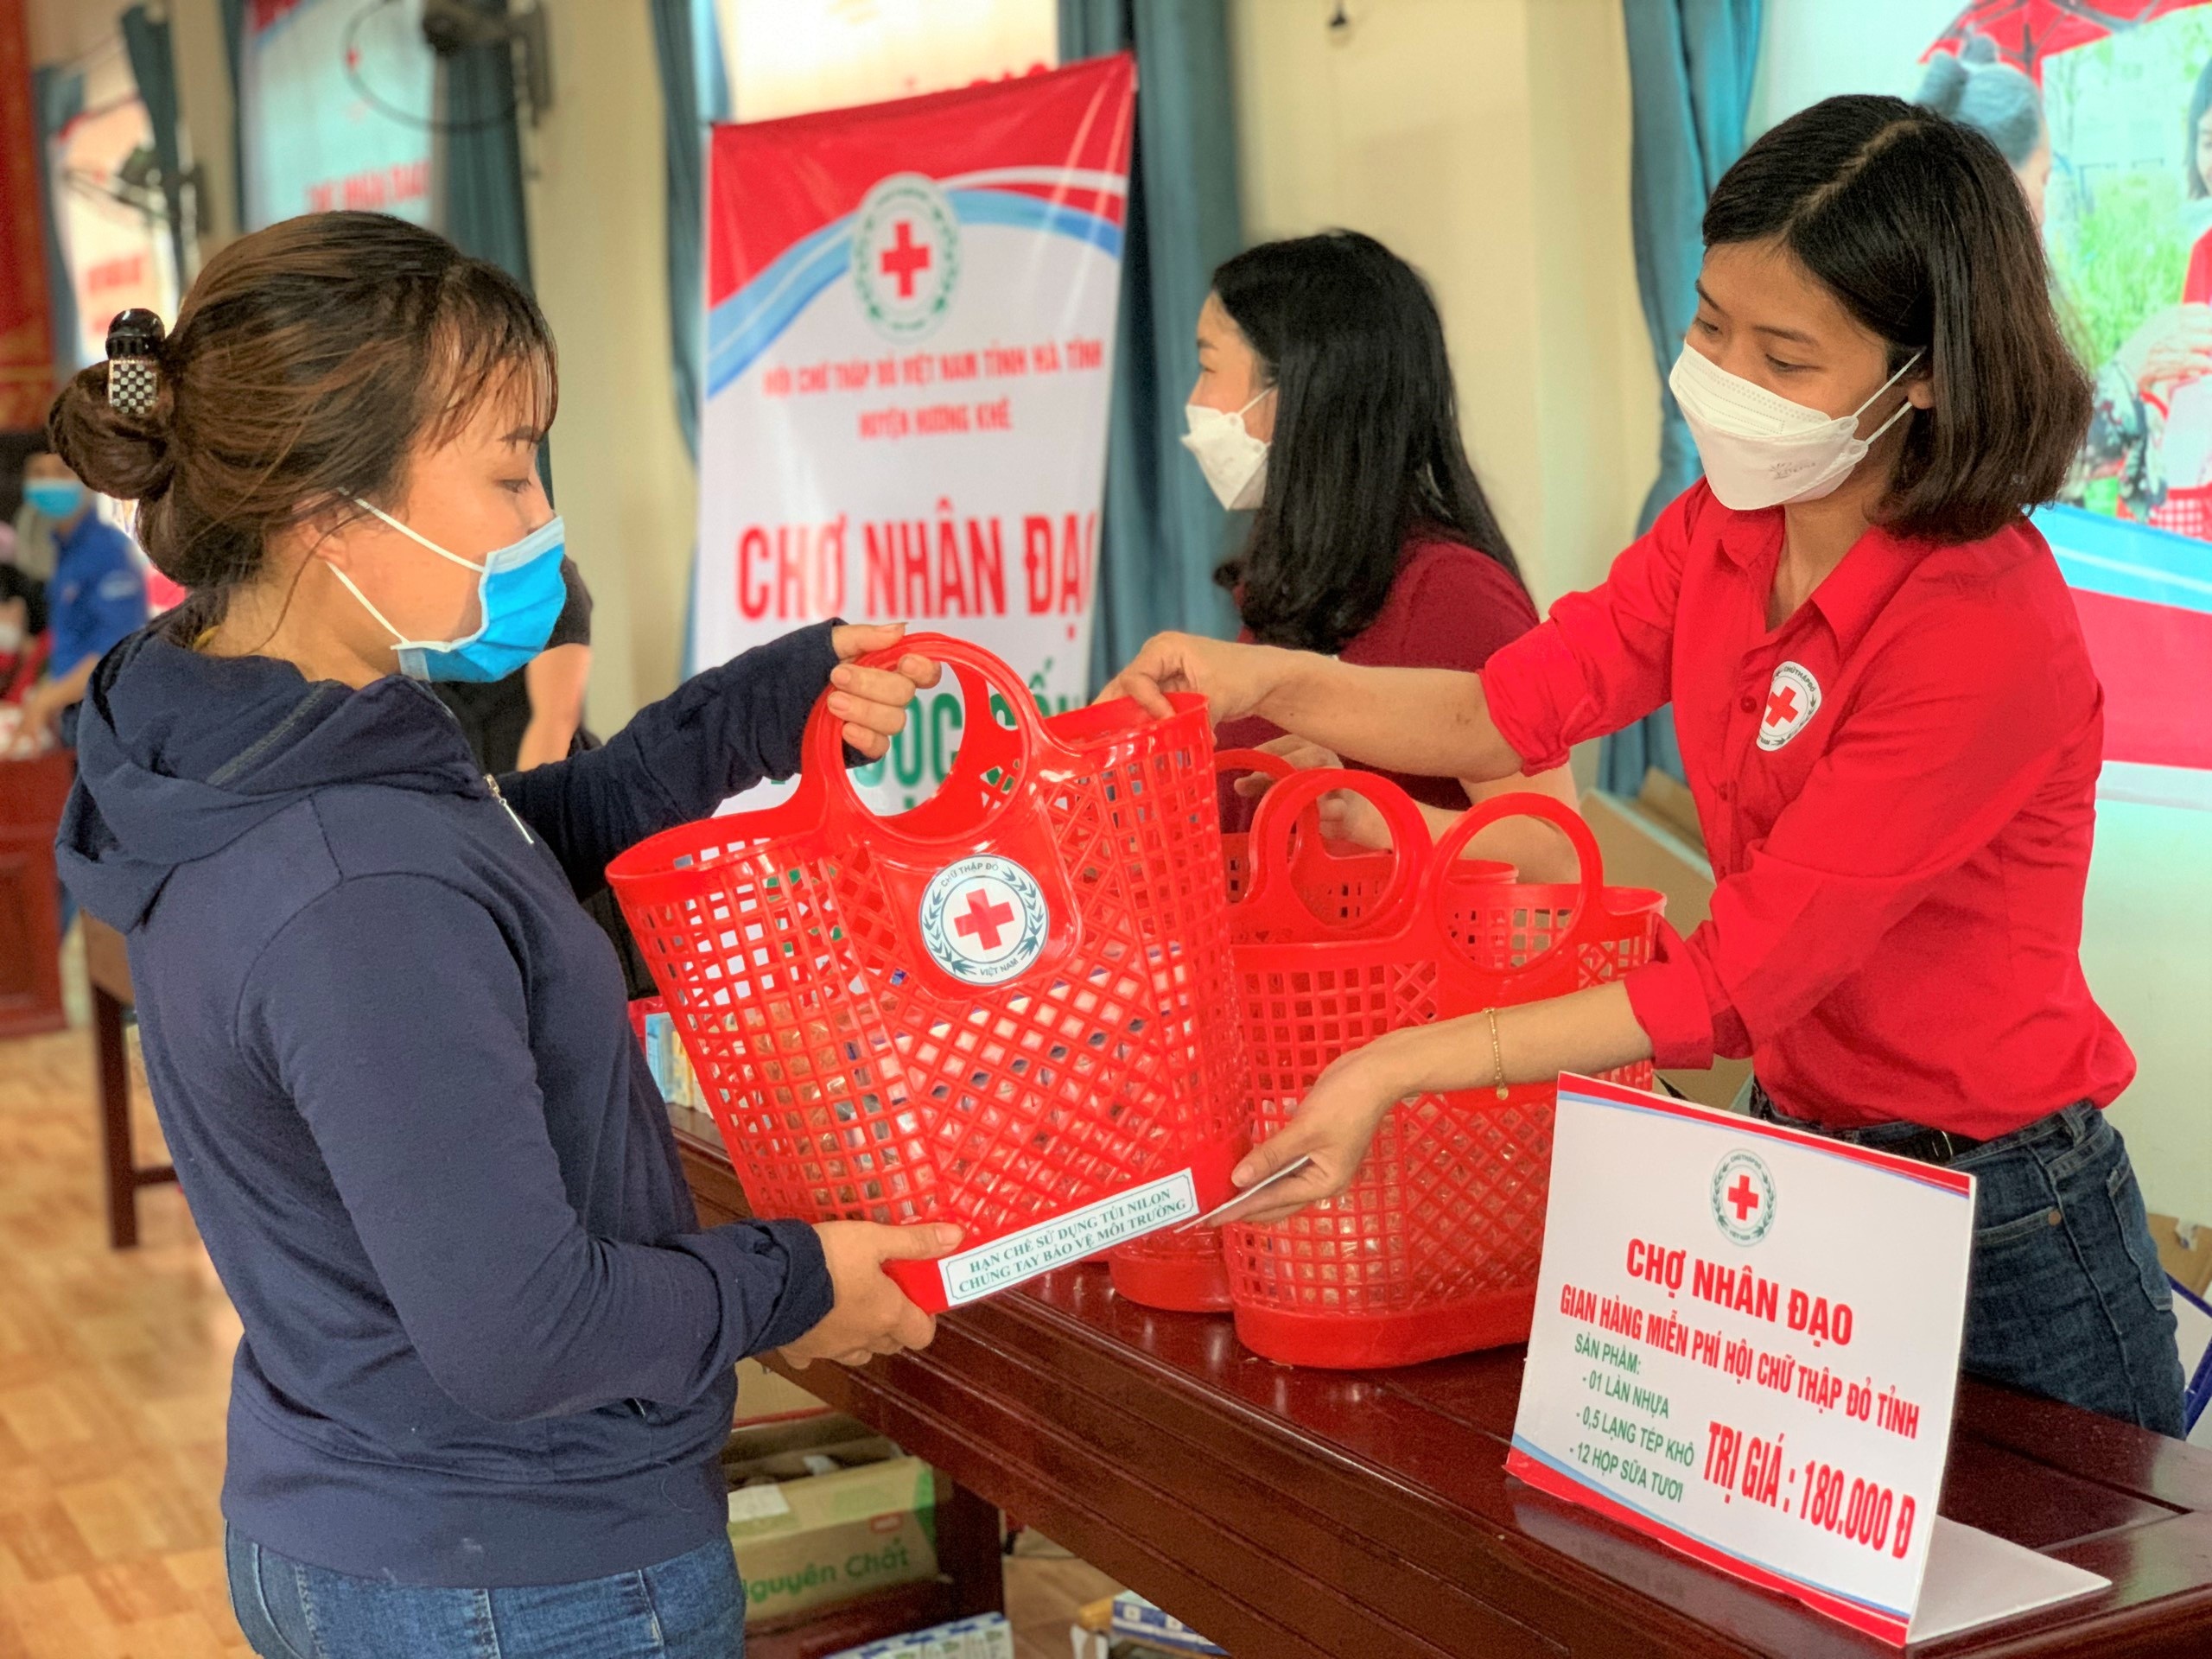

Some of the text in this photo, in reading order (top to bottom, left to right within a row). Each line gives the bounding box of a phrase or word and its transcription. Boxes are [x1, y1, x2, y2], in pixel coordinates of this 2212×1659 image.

[863, 496, 1005, 619] NHÂN
[1000, 957, 1019, 973] NAM
[959, 1265, 1012, 1293] CHUNG
[1014, 1254, 1040, 1273] TAY
[1076, 1233, 1095, 1249] VỆ
[1097, 1223, 1125, 1243] MÔI
[1128, 1198, 1187, 1230] TRƯỜNG
[969, 1252, 1001, 1273] HẠN
[1057, 1216, 1098, 1240] DỤNG
[1099, 1202, 1125, 1224] TÚI
[1127, 1188, 1171, 1214] NILON
[1626, 1238, 1853, 1348] CHỢ NHÂN ĐẠO
[1560, 1283, 1920, 1440] GIAN HÀNG MIỄN PHÍ HỘI CHỮ THẬP ĐỎ TỈNH
[1589, 1370, 1603, 1392] 01
[1632, 1386, 1669, 1419] NHỰA
[1577, 1441, 1591, 1464] 12
[1592, 1447, 1618, 1477] HỘP
[1620, 1458, 1647, 1488] SỮA
[1650, 1471, 1684, 1503] TƯƠI
[1582, 1405, 1601, 1430] 0,5
[1601, 1413, 1637, 1444] LẠNG
[1639, 1426, 1664, 1453] TÉP
[1665, 1438, 1695, 1467] KHÔ
[1703, 1420, 1743, 1504] TRỊ
[1740, 1432, 1785, 1509] GIÁ
[1799, 1459, 1894, 1551] 180.000
[1891, 1494, 1916, 1560] Đ
